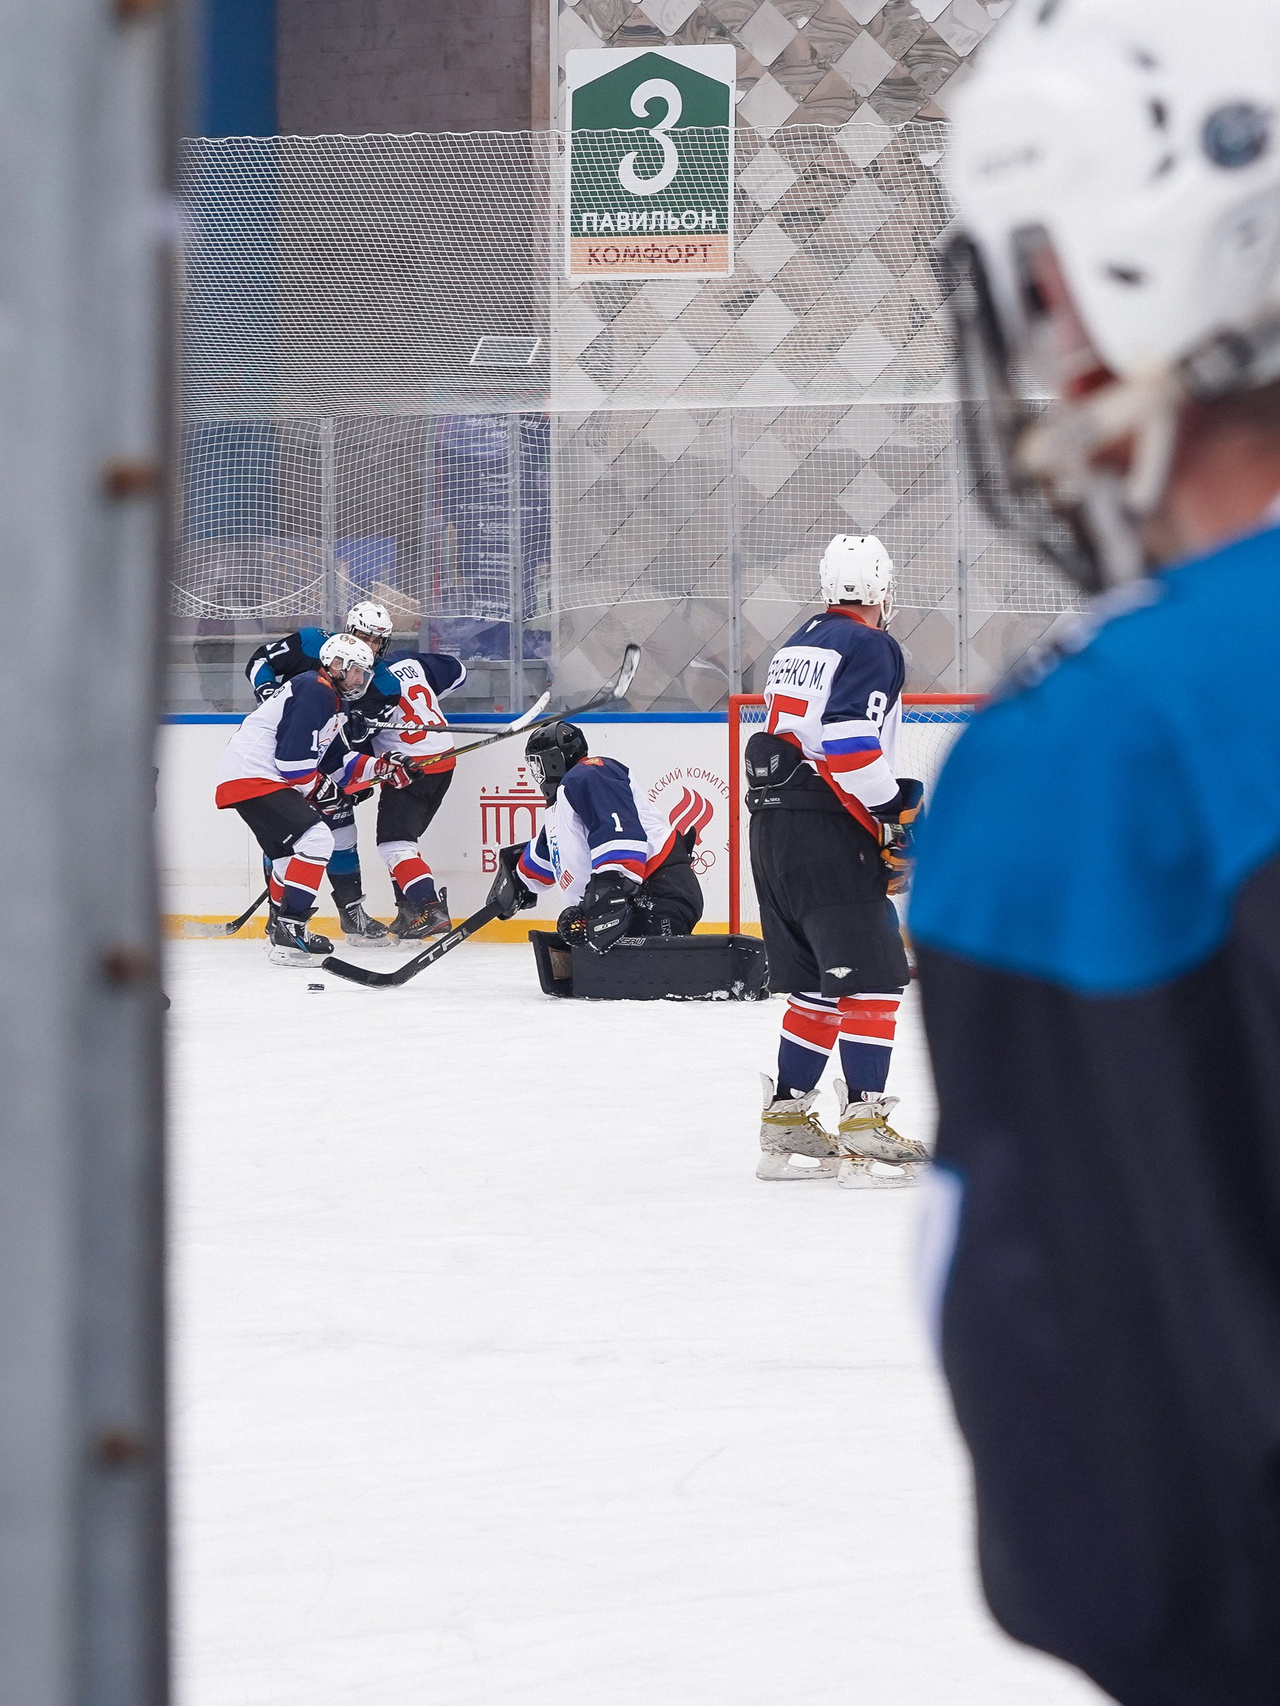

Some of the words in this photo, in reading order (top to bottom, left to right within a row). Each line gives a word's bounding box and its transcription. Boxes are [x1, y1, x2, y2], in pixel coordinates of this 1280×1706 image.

[618, 78, 683, 196] 3
[582, 209, 718, 232] ПАВИЛЬОН
[588, 243, 712, 265] КОМФОРТ
[611, 812, 624, 832] 1
